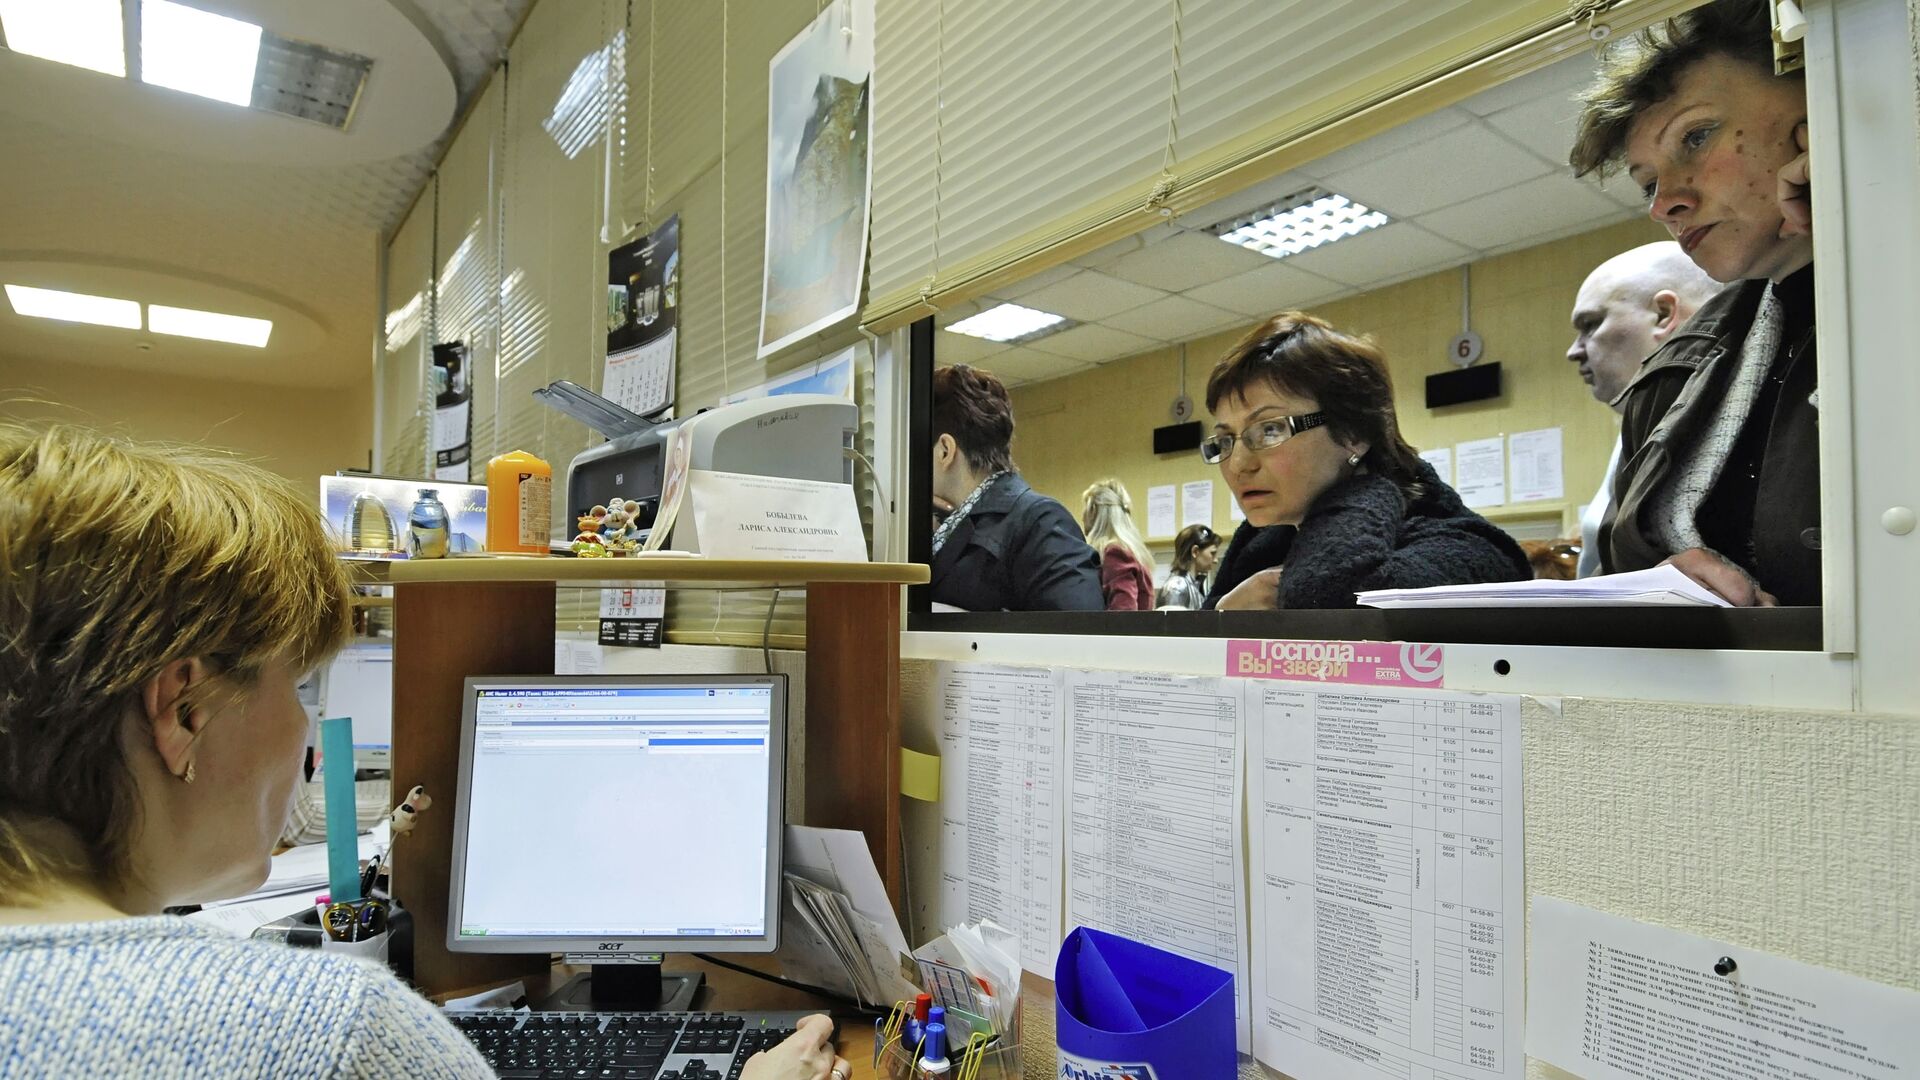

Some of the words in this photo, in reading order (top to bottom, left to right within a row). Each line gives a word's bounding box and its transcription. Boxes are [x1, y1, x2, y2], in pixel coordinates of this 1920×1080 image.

[1458, 340, 1470, 358] 6
[1176, 401, 1185, 416] 5
[766, 511, 808, 521] БОБЫЛЕВА
[738, 524, 772, 532] ЛАРИСА
[774, 526, 838, 536] АЛЕКСАНДРОВНА
[598, 942, 624, 950] acer
